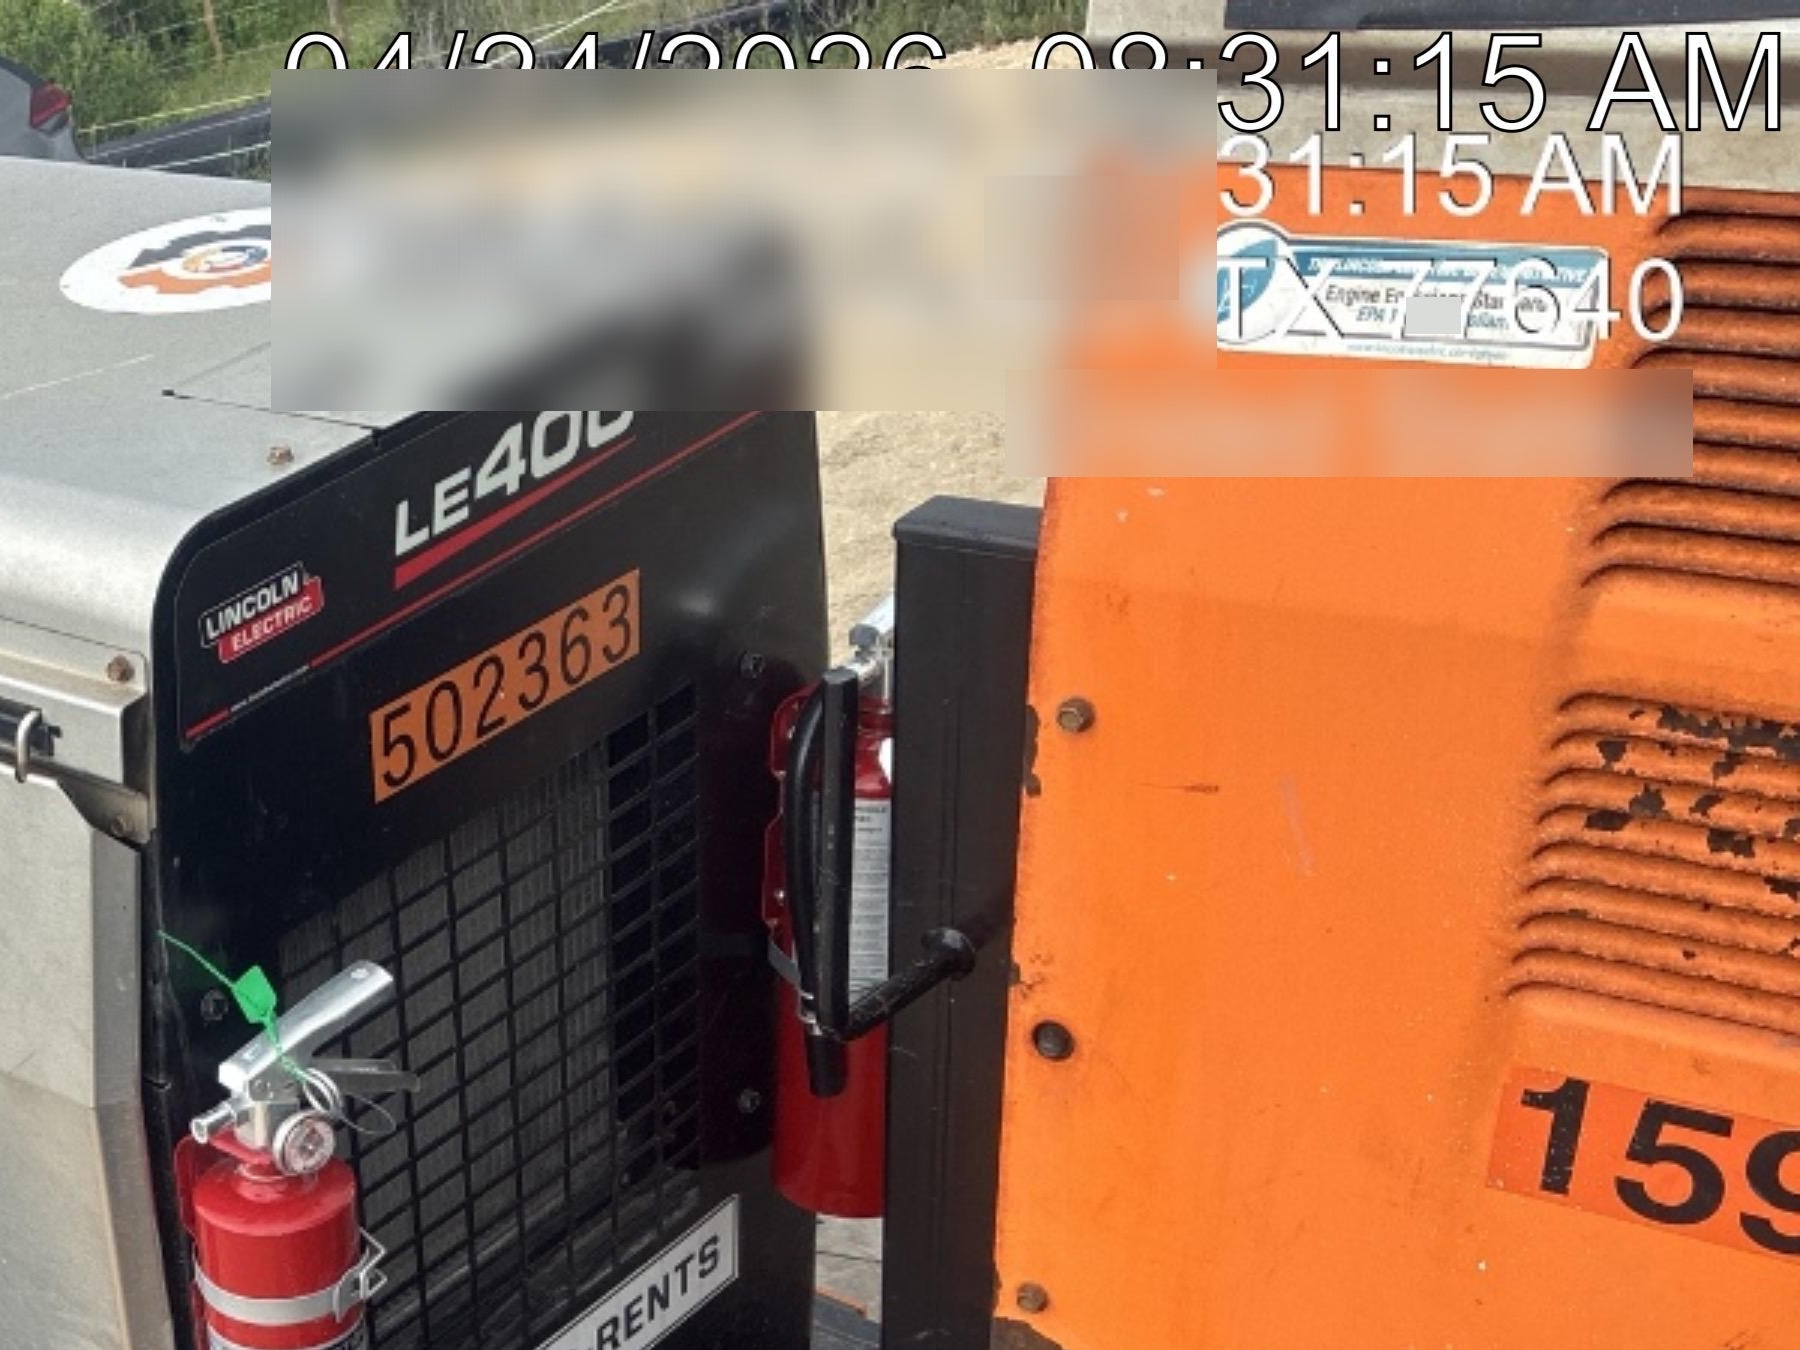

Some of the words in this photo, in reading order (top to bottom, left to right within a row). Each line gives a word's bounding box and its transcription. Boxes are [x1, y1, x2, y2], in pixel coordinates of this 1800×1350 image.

[205, 571, 299, 639] LINCOLN
[231, 596, 313, 652] ELECTRIC
[382, 584, 632, 788] 502363
[1520, 1076, 1800, 1255] 159
